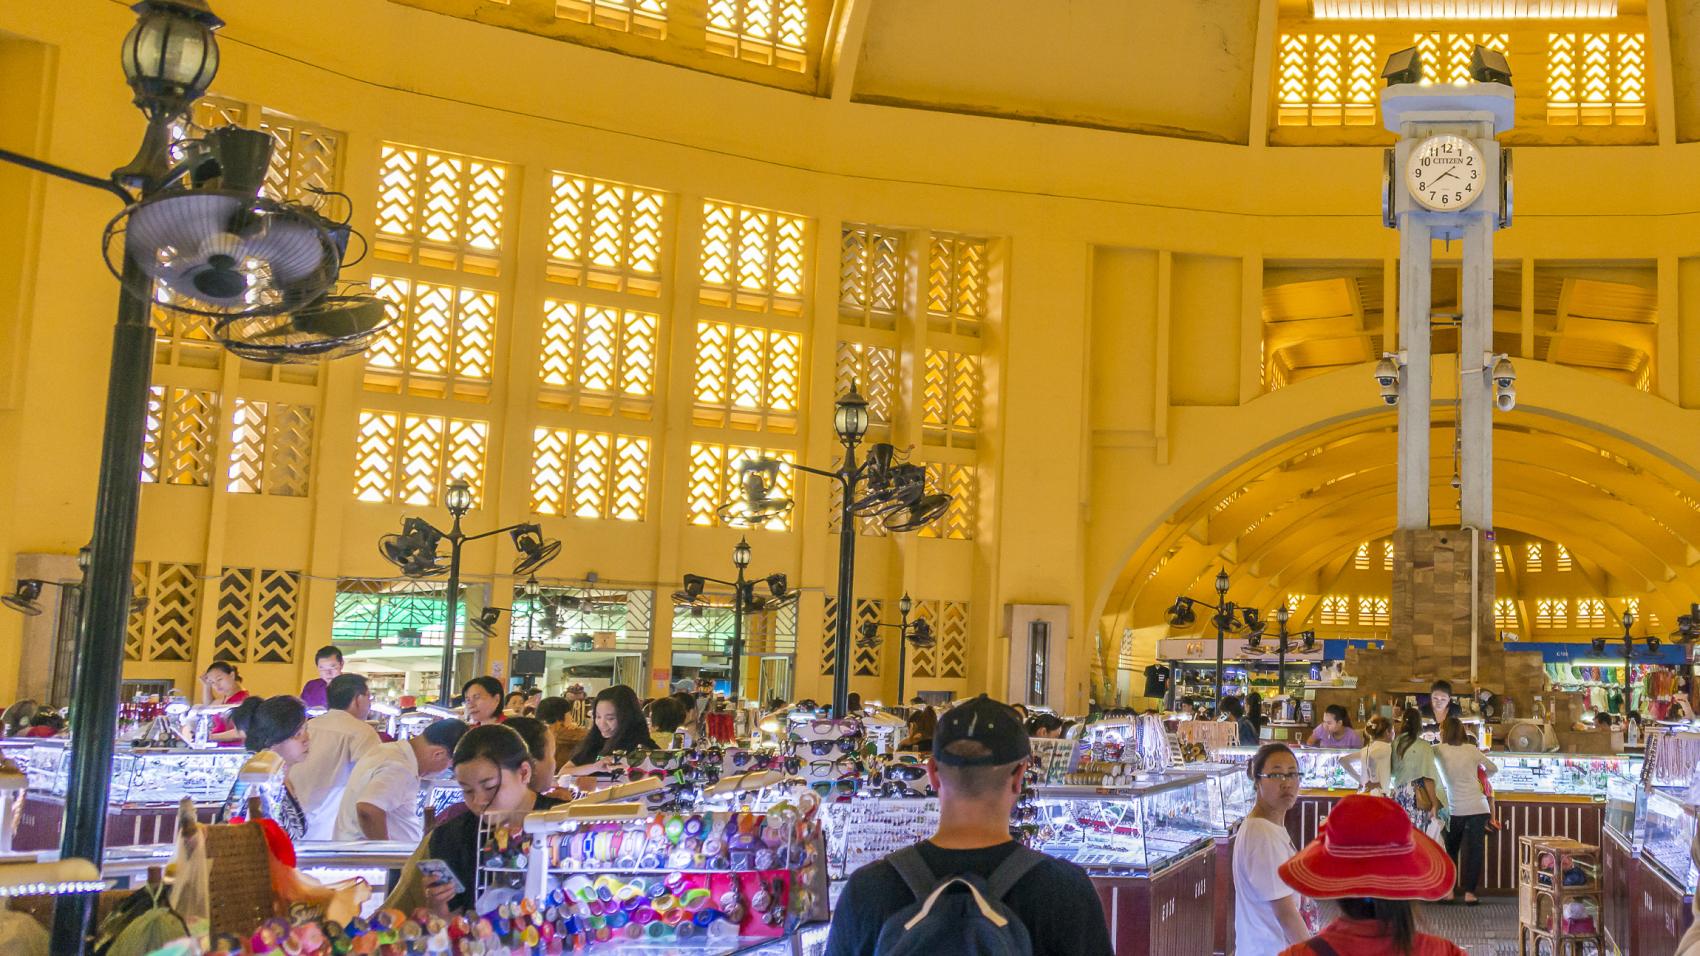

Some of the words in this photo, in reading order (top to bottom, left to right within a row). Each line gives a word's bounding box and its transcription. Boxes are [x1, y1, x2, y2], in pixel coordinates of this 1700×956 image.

[1430, 148, 1438, 156] 11
[1441, 144, 1452, 153] 12
[1420, 157, 1430, 166] 10
[1466, 156, 1473, 166] 2
[1415, 169, 1422, 178] 9
[1470, 170, 1477, 179] 3
[1419, 182, 1425, 191] 8
[1465, 183, 1472, 192] 4
[1430, 191, 1436, 200] 7
[1442, 195, 1448, 204] 6
[1456, 192, 1462, 201] 5
